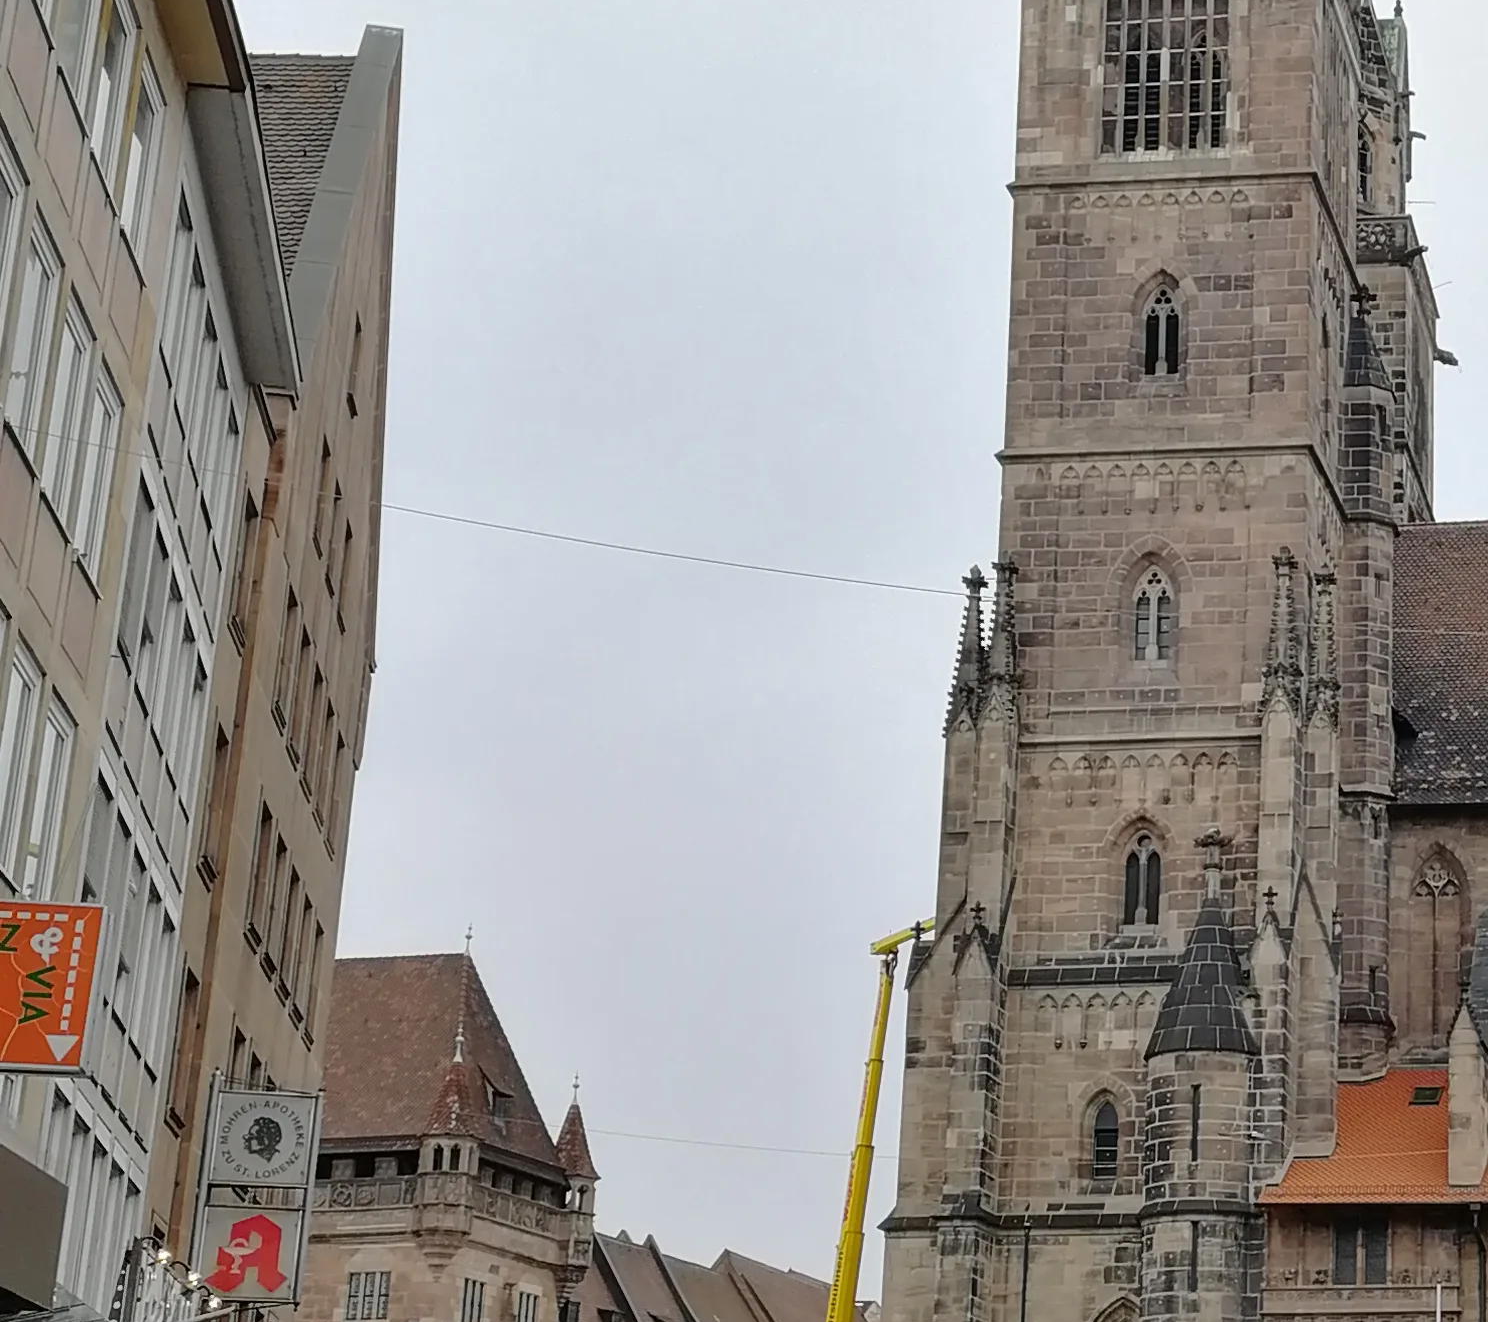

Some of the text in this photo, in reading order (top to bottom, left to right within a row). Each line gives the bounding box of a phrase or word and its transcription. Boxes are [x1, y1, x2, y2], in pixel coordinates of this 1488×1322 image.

[18, 965, 56, 1025] VIA
[222, 1149, 235, 1164] ZU
[254, 1151, 299, 1179] LORENZ
